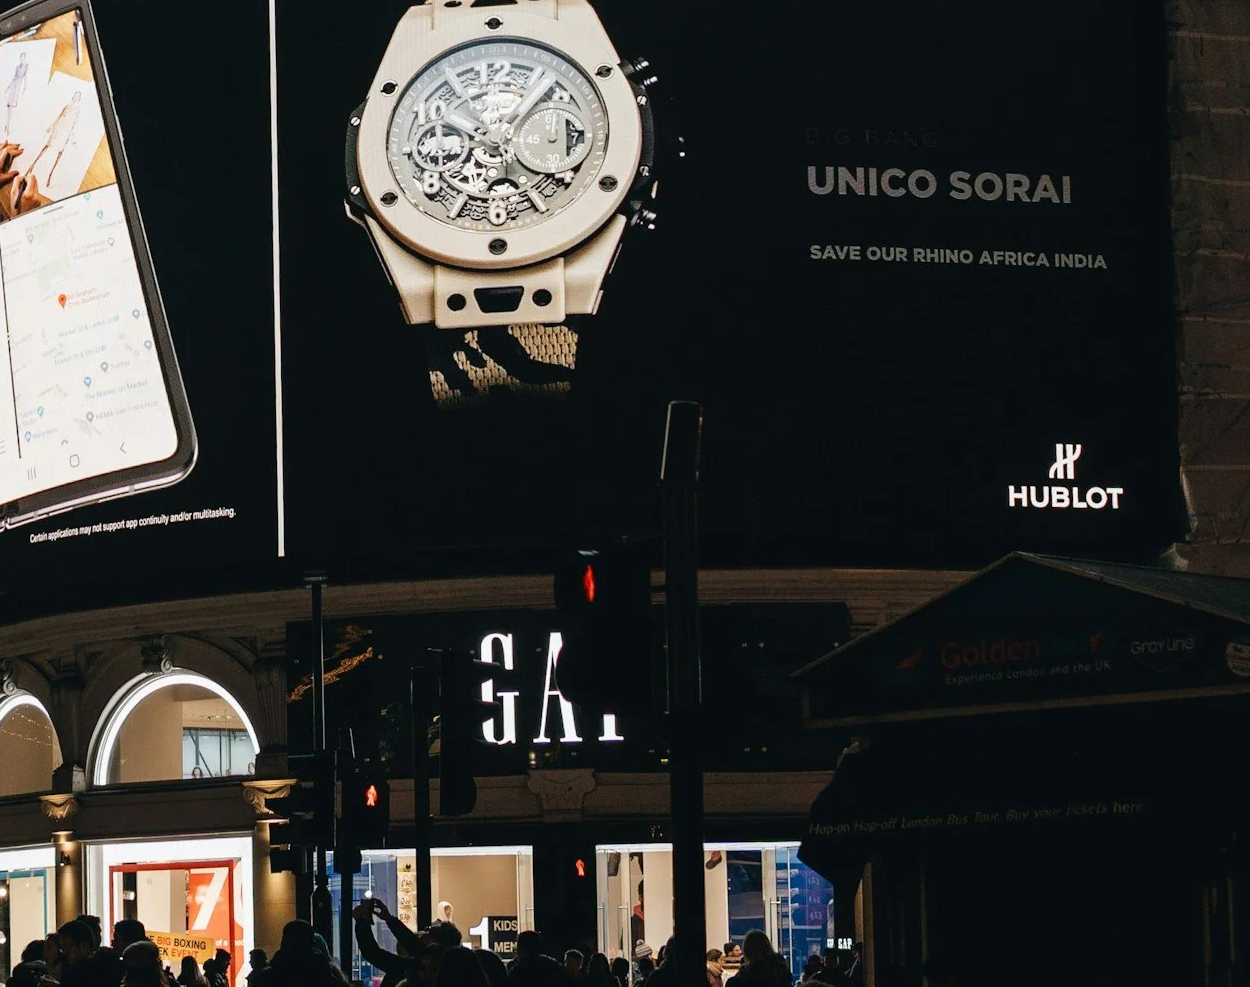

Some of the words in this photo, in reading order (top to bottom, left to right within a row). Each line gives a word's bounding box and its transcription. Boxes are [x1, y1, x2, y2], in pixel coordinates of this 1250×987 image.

[526, 134, 540, 145] 45
[547, 153, 560, 164] 30
[807, 165, 937, 199] UNICO
[949, 170, 1071, 204] SORAI
[488, 197, 508, 225] 6
[809, 244, 861, 261] SAVE
[866, 246, 908, 262] OUR
[913, 247, 973, 264] RHINO
[979, 249, 1049, 267] AFRICA
[1054, 252, 1108, 269] INDIA
[1008, 485, 1124, 510] HUBLOT
[29, 532, 48, 544] Certain
[48, 526, 79, 542] applications
[79, 525, 92, 536] may
[92, 522, 102, 533] not
[102, 519, 125, 532] support
[126, 518, 138, 530] app
[139, 513, 169, 528] continuity
[170, 510, 192, 523] and/or
[193, 507, 237, 520] multitasking.
[938, 636, 1041, 669] Golden
[945, 669, 1003, 686] Experience
[1006, 667, 1046, 680] London
[1049, 663, 1069, 675] and
[1073, 662, 1091, 674] the
[1095, 659, 1112, 671] UK
[479, 631, 625, 746] GA
[808, 821, 851, 836] Hop-on
[853, 817, 897, 833] Hop-off
[901, 814, 943, 829] London
[947, 813, 969, 826] Bus
[1006, 808, 1029, 823] Buy
[1034, 807, 1062, 821] your
[1066, 802, 1107, 817] tickets
[1113, 800, 1143, 814] here
[494, 920, 518, 931] KIDS
[157, 937, 171, 946] BIG
[174, 938, 206, 950] BOXING
[171, 948, 198, 959] EVENT
[838, 937, 853, 950] GAP
